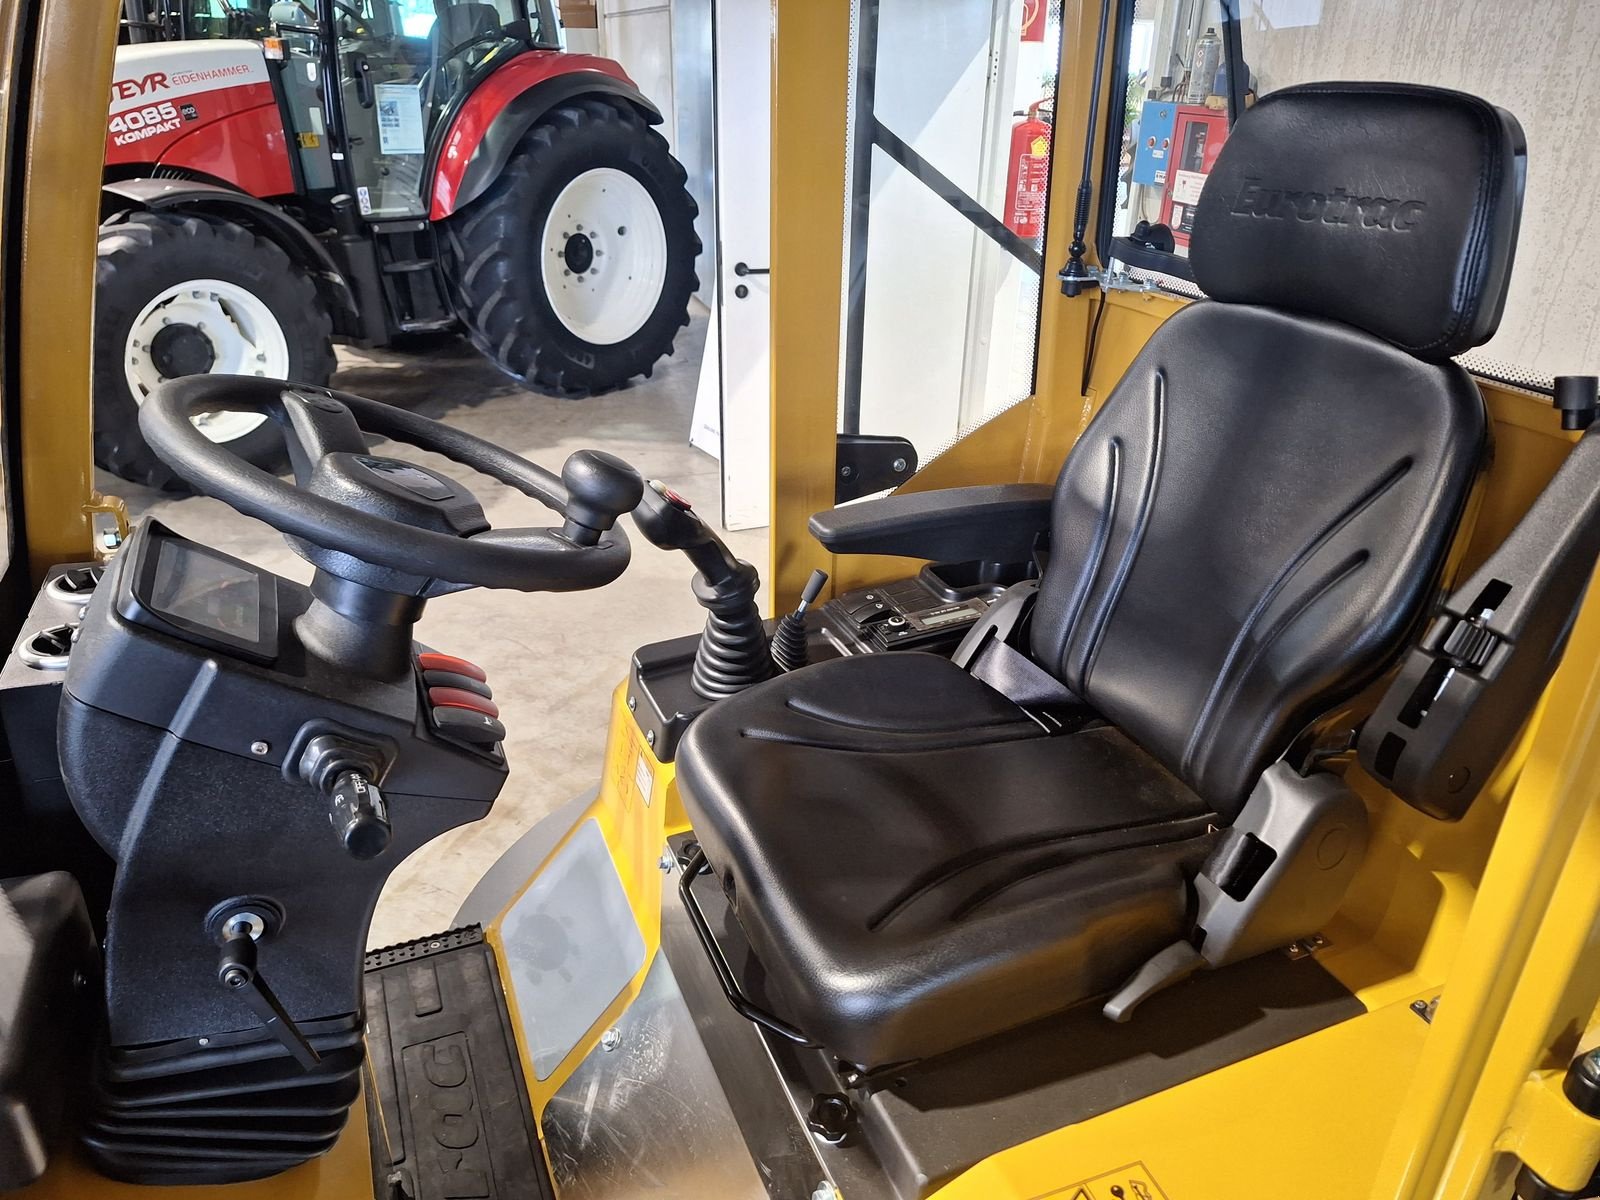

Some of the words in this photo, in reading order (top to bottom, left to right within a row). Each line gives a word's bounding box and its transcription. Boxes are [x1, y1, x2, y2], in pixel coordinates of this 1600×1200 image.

[172, 65, 249, 85] EIDENHAMMER
[108, 102, 178, 132] 4085
[114, 118, 181, 145] KOMPAKT
[1231, 177, 1426, 232] Eurotrac
